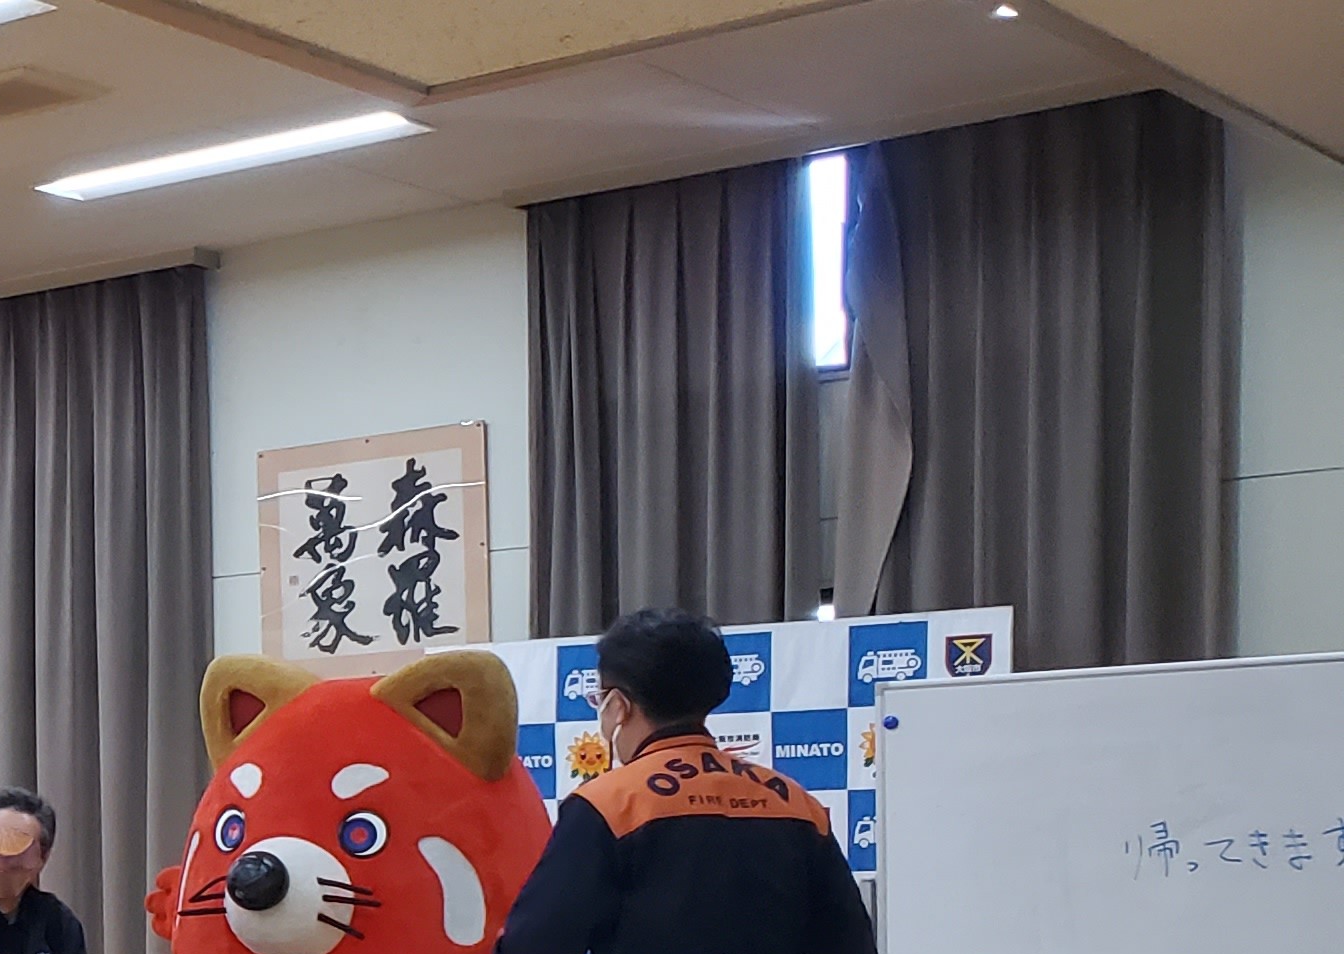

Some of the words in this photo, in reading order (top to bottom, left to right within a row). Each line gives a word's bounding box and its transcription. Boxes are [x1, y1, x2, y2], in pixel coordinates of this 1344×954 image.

[775, 742, 844, 759] MINATO
[518, 755, 553, 768] ATO
[647, 752, 790, 803] OSAKA
[688, 795, 723, 806] FIRE
[729, 798, 768, 808] DEPT
